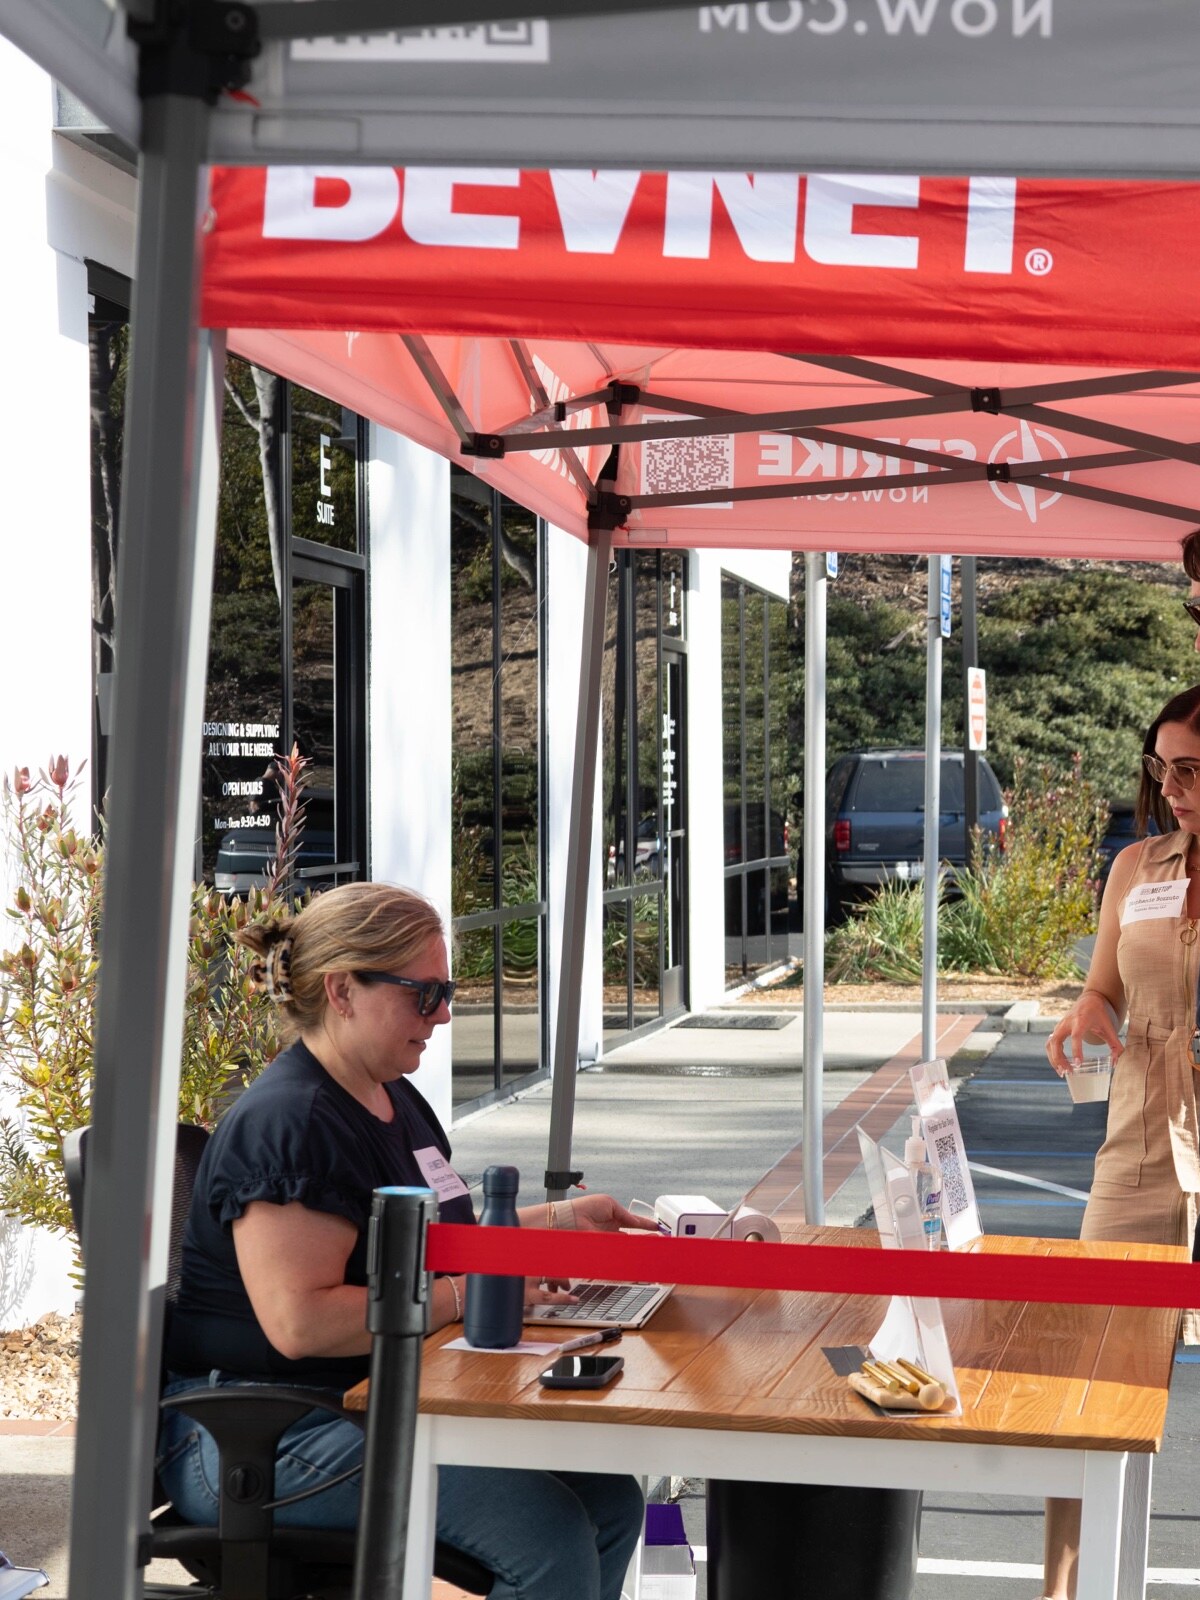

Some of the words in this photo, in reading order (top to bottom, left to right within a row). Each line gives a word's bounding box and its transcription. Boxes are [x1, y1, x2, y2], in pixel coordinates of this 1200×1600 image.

[316, 500, 335, 526] SUITE
[203, 722, 239, 737] DESIGNING
[246, 724, 279, 738] SUPPLYING
[208, 742, 220, 756] ALL
[221, 742, 240, 756] YOUR
[240, 742, 254, 757] TILE
[222, 782, 240, 796] OPEN
[240, 781, 263, 795] HOURS
